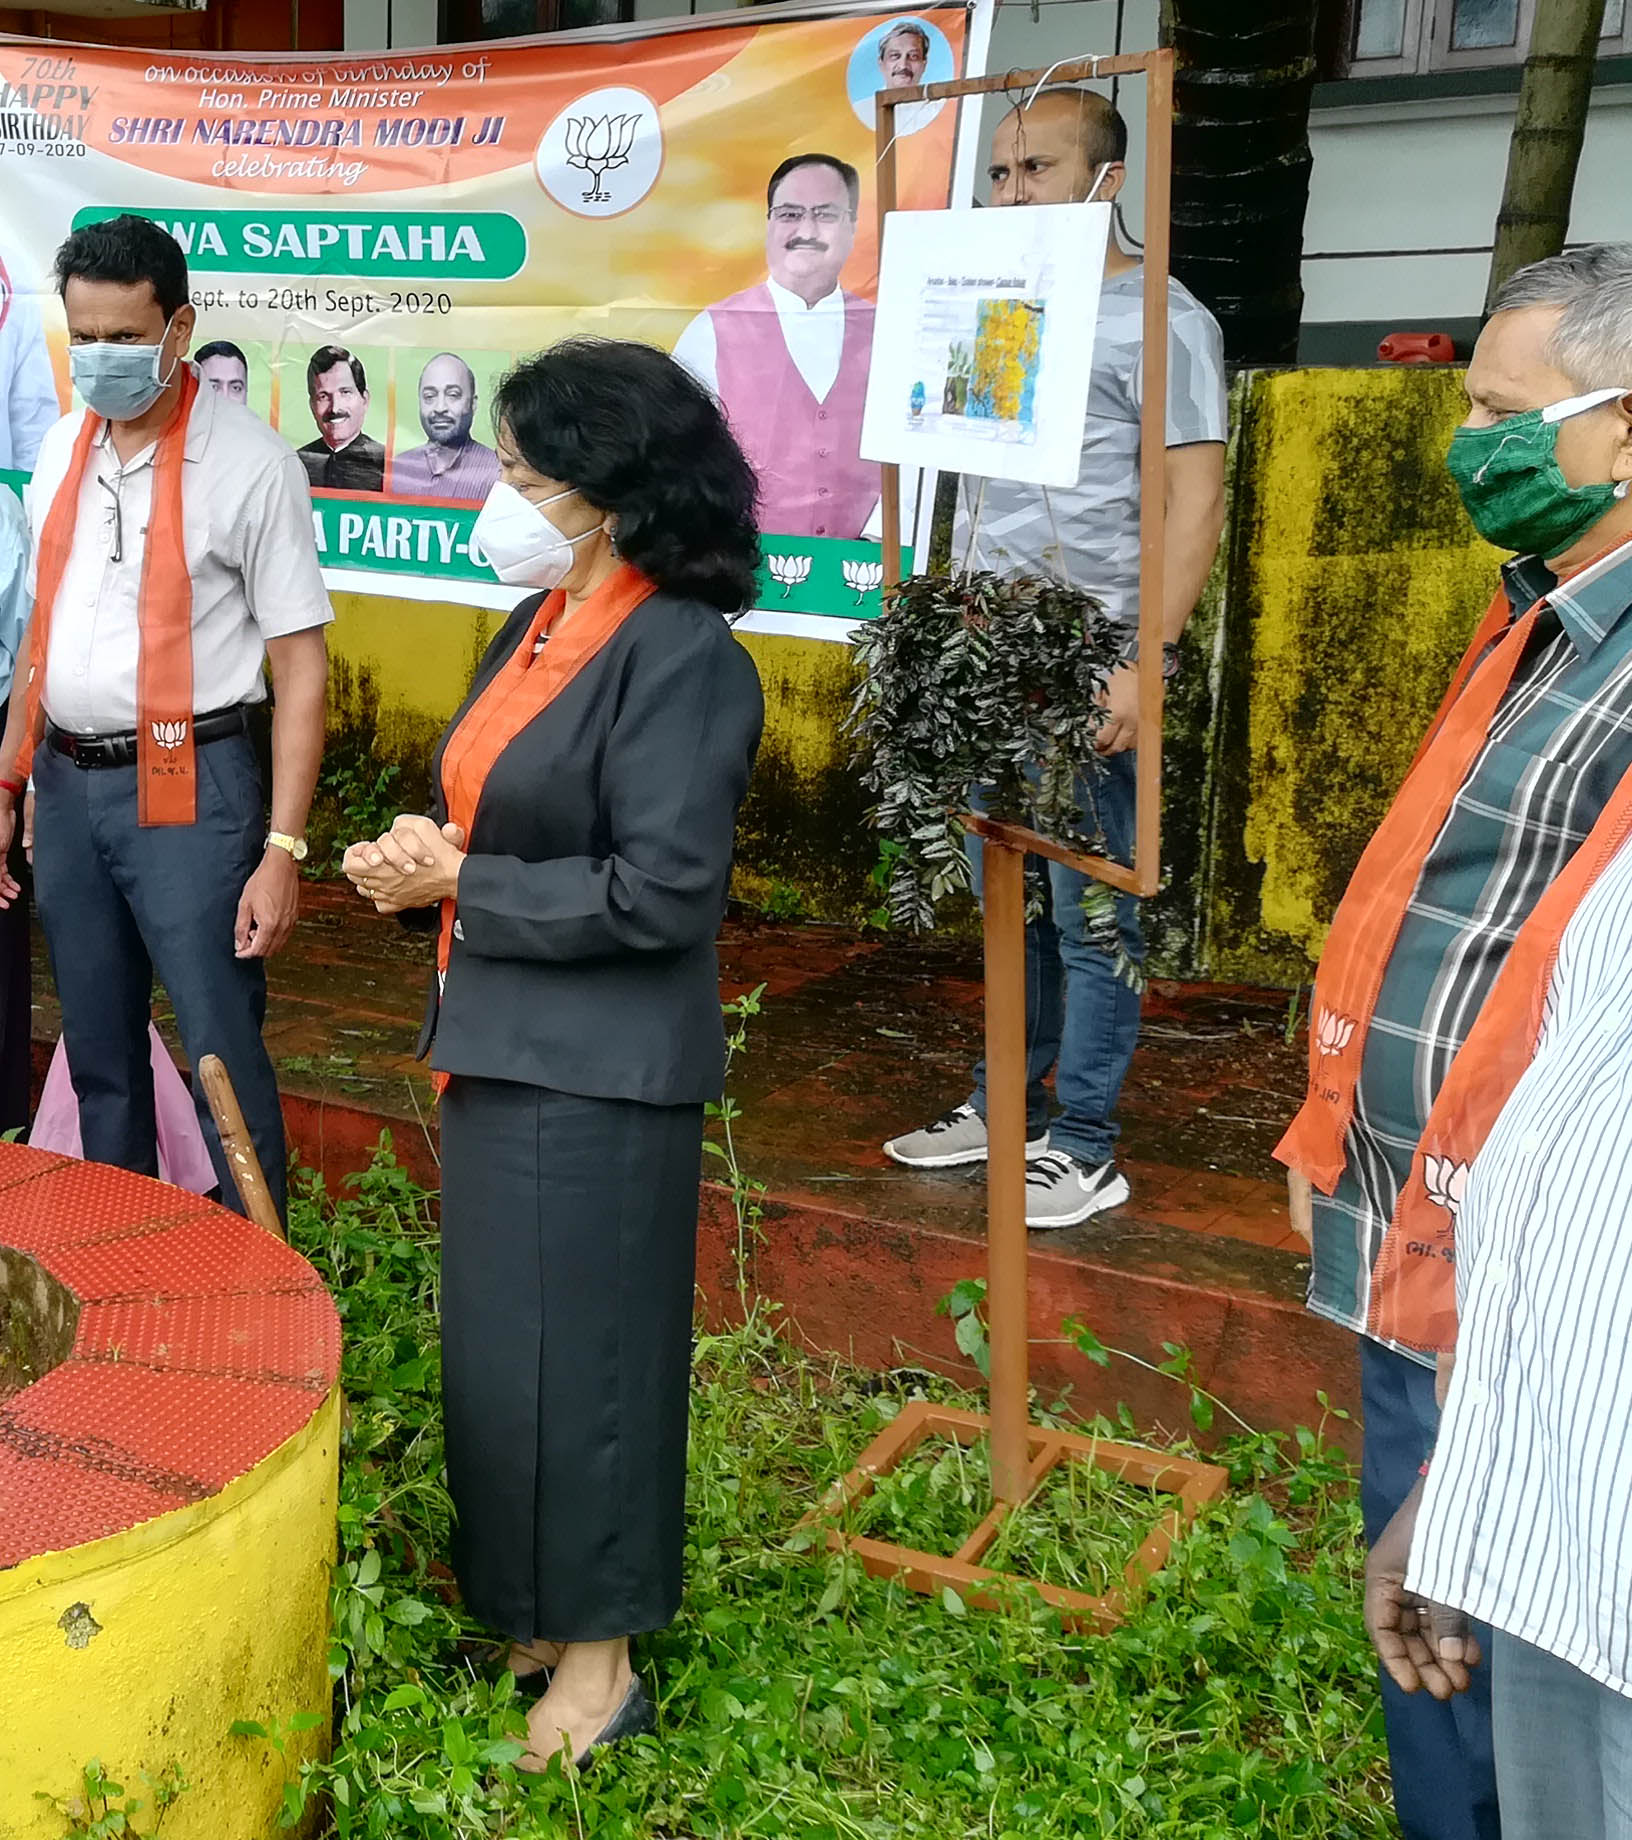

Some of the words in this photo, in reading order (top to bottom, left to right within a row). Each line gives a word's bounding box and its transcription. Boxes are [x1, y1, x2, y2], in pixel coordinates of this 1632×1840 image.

[21, 57, 76, 80] 70th
[144, 65, 180, 83] on
[185, 66, 296, 85] occasion
[303, 67, 328, 87] of
[333, 61, 454, 86] birthday
[461, 56, 492, 83] of
[198, 88, 249, 109] Hon.
[257, 88, 322, 109] Prime
[328, 88, 424, 108] Minister
[108, 117, 186, 145] SHRI
[192, 118, 363, 148] NARENDRA
[373, 116, 466, 148] MODI
[472, 116, 506, 145] JI
[212, 153, 369, 186] celebrating
[154, 221, 229, 257] WA
[242, 222, 486, 262] SAPTAHA
[191, 289, 230, 312] ept.
[238, 290, 258, 309] to
[268, 289, 317, 311] 20th
[325, 290, 381, 317] Sept.
[390, 292, 452, 314] 2020
